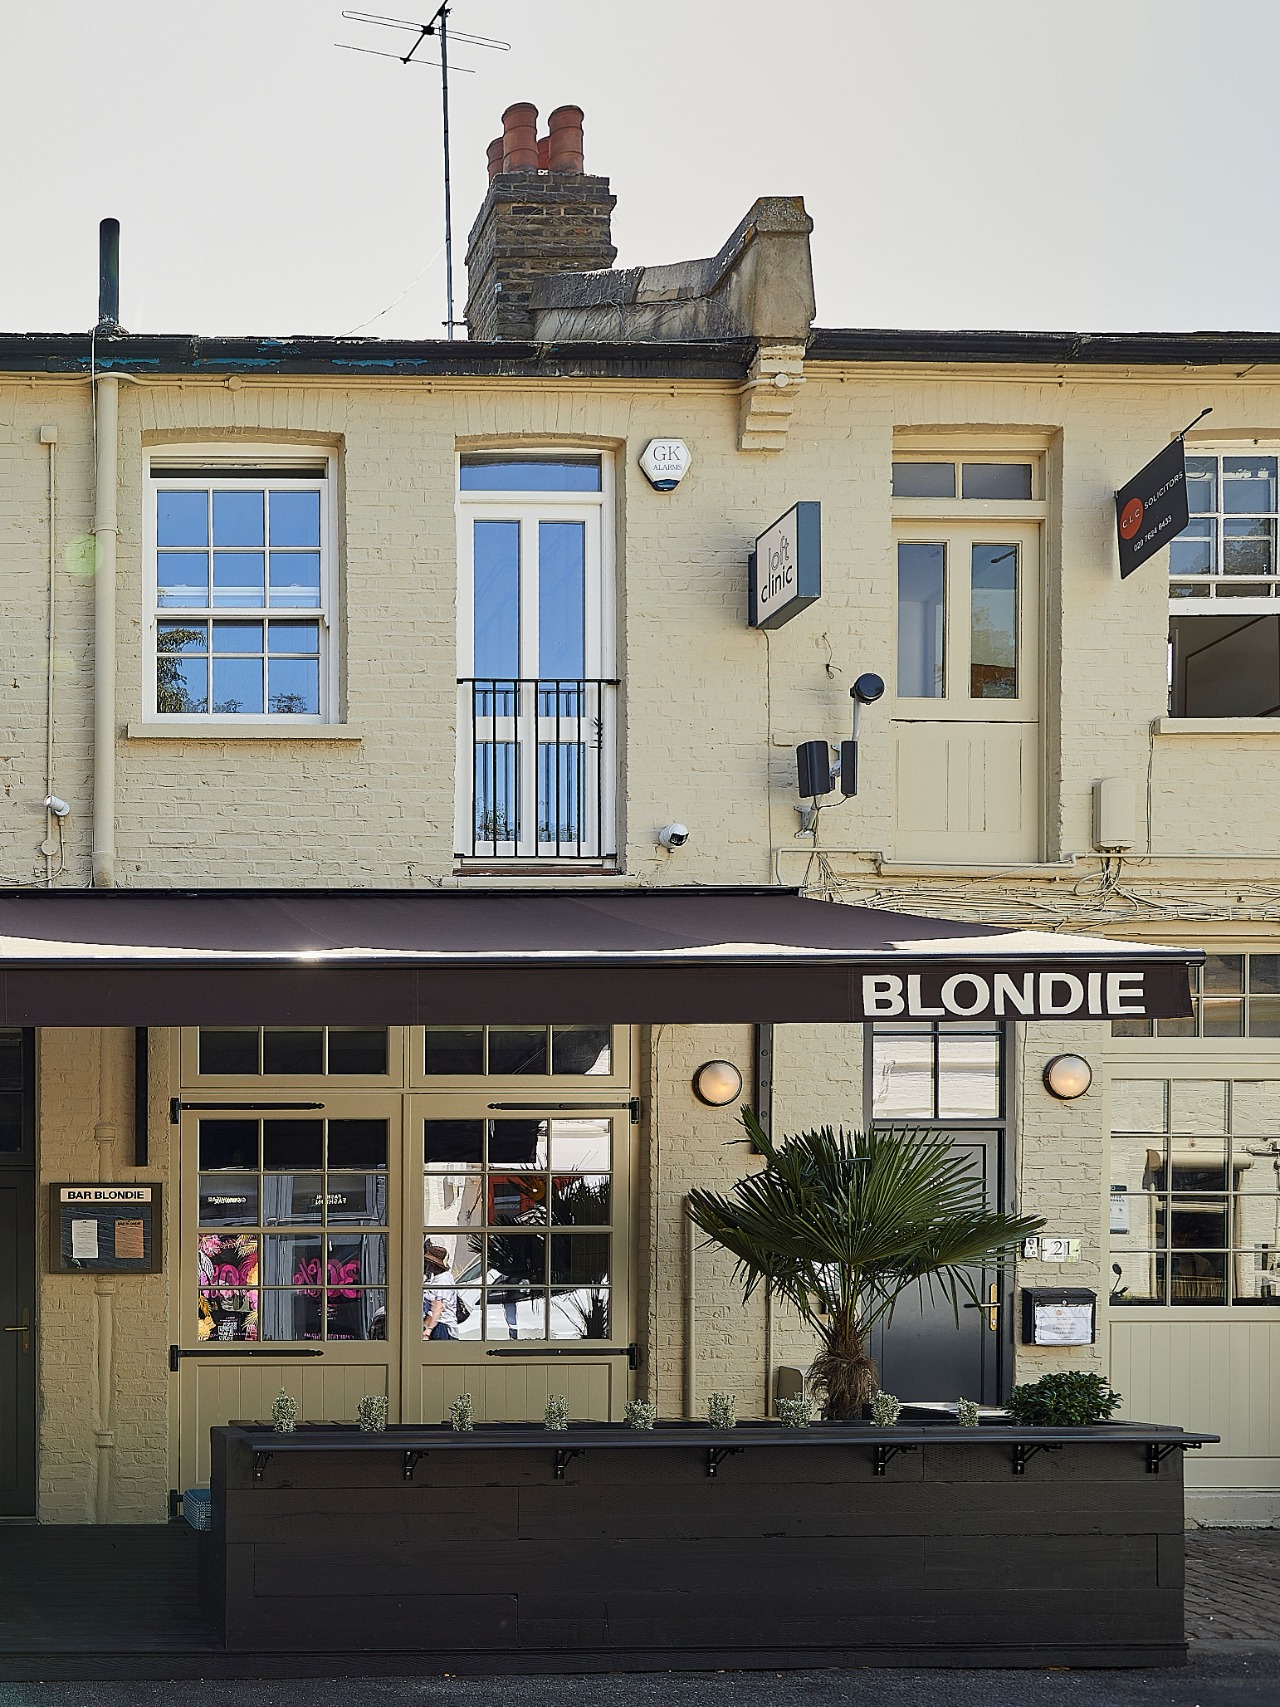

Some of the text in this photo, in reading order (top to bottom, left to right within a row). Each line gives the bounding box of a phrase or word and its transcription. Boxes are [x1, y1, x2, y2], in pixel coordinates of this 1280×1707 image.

[652, 445, 681, 462] GK
[1144, 470, 1184, 510] SOLICITORS
[767, 535, 790, 572] loft
[1133, 539, 1144, 552] 020
[760, 565, 793, 604] clinic
[862, 972, 1147, 1016] BLONDIE
[67, 1190, 145, 1200] BAR BLONDIE
[1050, 1240, 1071, 1256] 21
